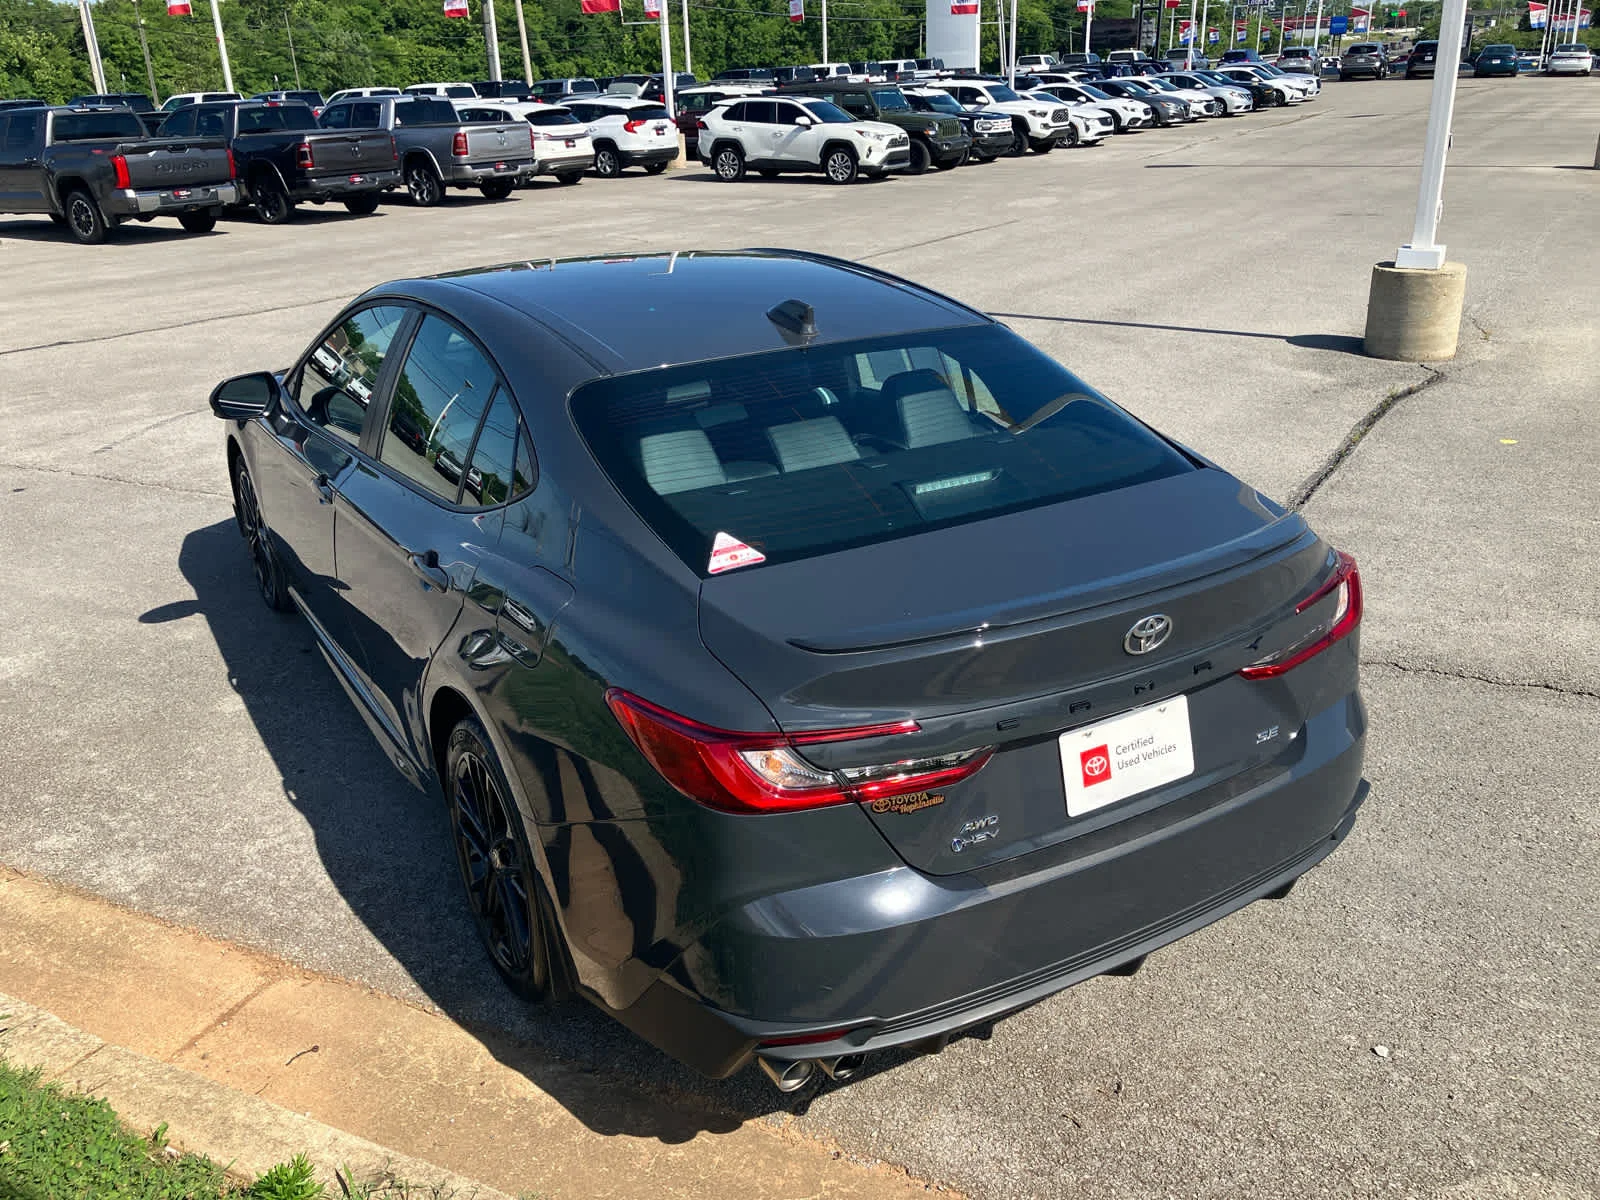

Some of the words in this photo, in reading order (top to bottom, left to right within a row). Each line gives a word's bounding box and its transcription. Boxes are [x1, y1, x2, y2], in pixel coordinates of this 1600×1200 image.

[1256, 725, 1280, 744] SE
[1115, 736, 1155, 756] Certified
[1117, 753, 1140, 770] Used
[1141, 743, 1177, 761] Vehicles
[890, 791, 929, 805] TOYOTA
[960, 815, 999, 833] AWD
